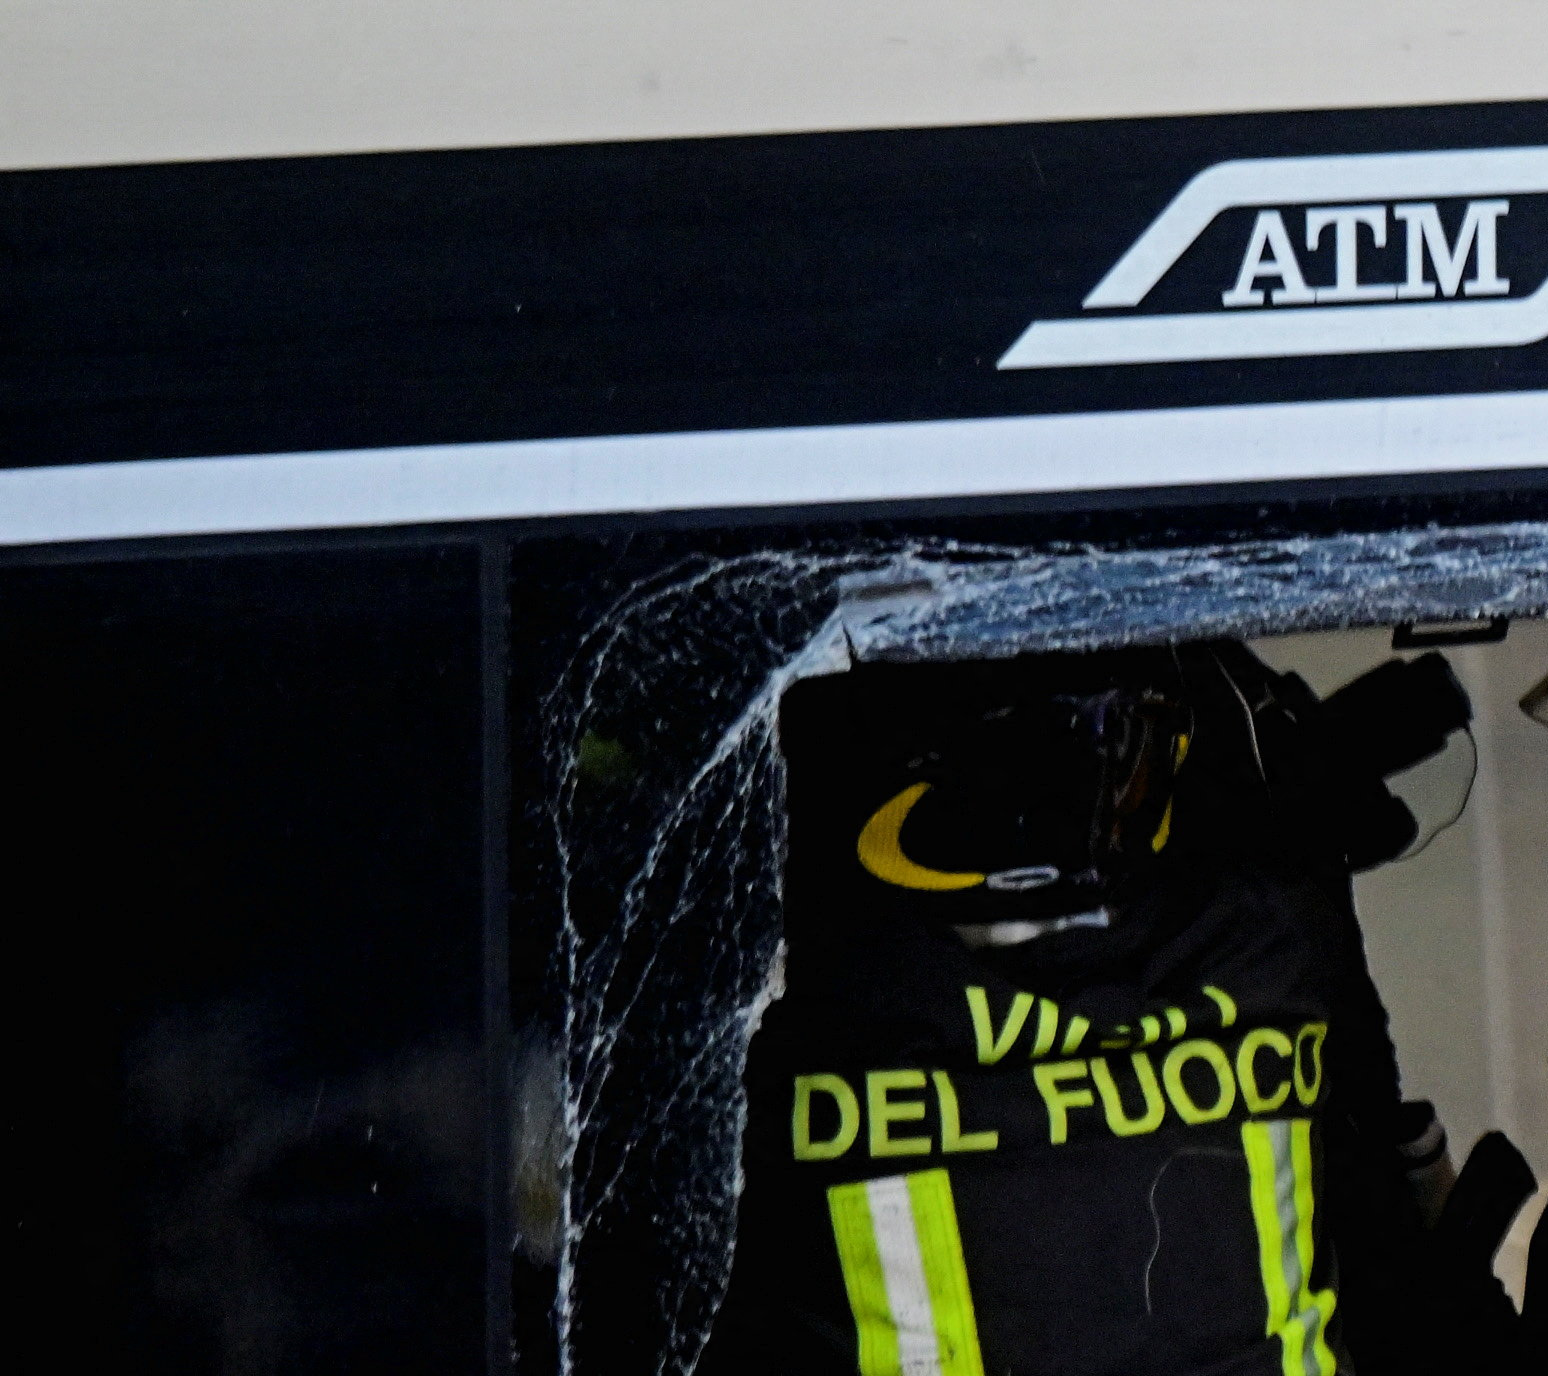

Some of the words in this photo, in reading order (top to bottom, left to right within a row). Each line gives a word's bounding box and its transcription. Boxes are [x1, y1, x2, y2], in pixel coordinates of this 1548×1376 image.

[1222, 200, 1510, 307] ATM
[792, 1069, 998, 1162] DEL
[1033, 1022, 1328, 1145] FUOCO
